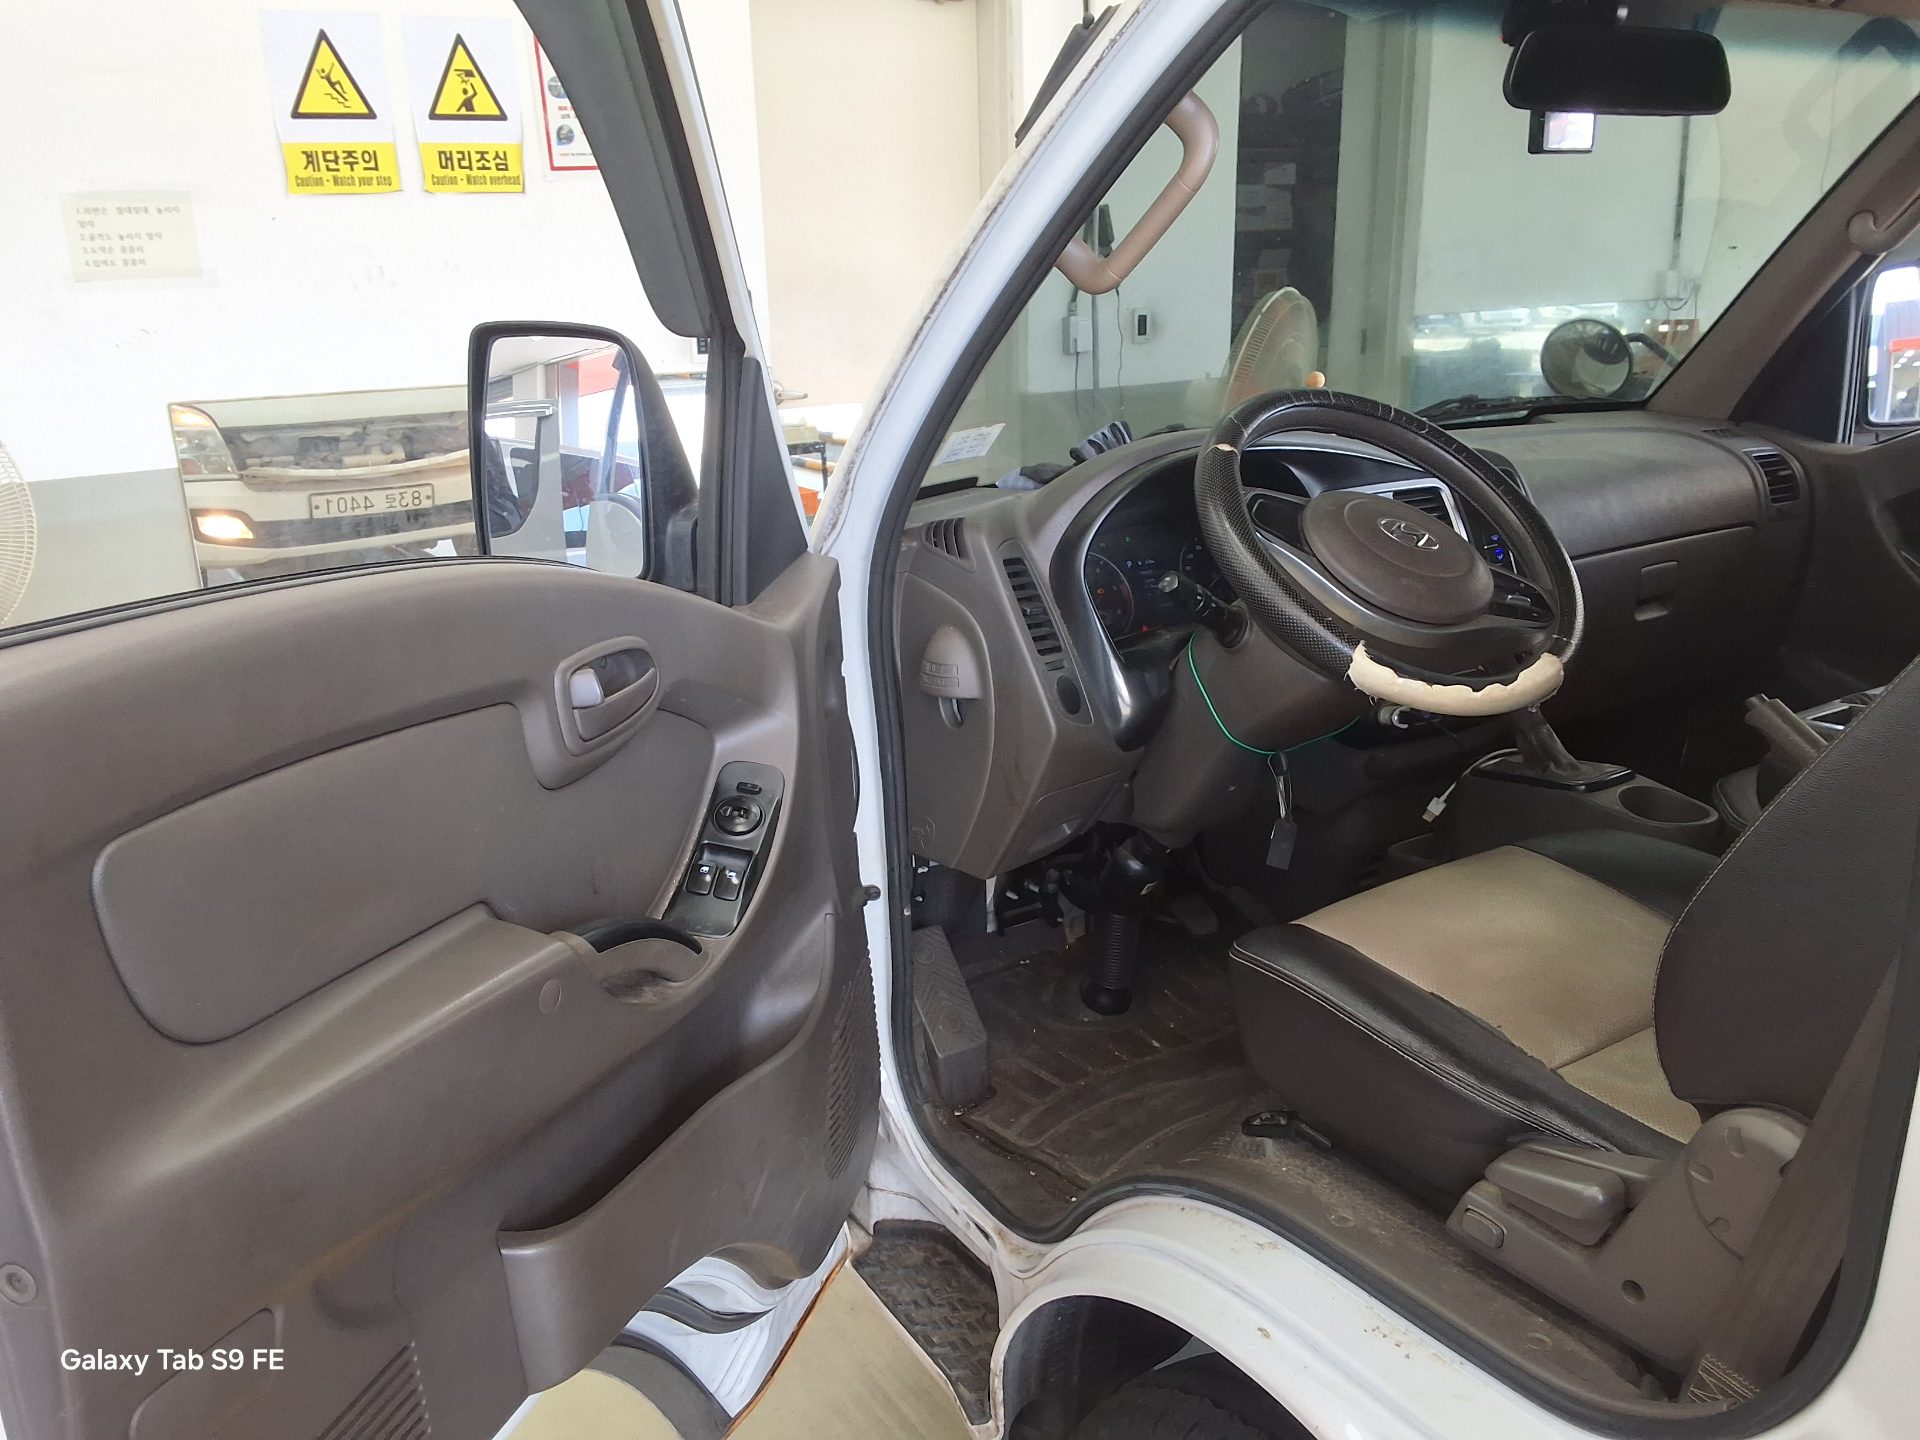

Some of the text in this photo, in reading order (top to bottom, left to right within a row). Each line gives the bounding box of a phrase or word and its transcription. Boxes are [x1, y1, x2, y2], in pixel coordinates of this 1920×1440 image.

[301, 150, 379, 172] 계단주의
[438, 150, 509, 171] 머리조심
[295, 175, 324, 187] Caution
[332, 174, 356, 187] Watch
[357, 175, 373, 187] your
[376, 175, 392, 187] step
[431, 174, 459, 186] Caution
[465, 173, 487, 186] Watch
[489, 174, 521, 186] overhead
